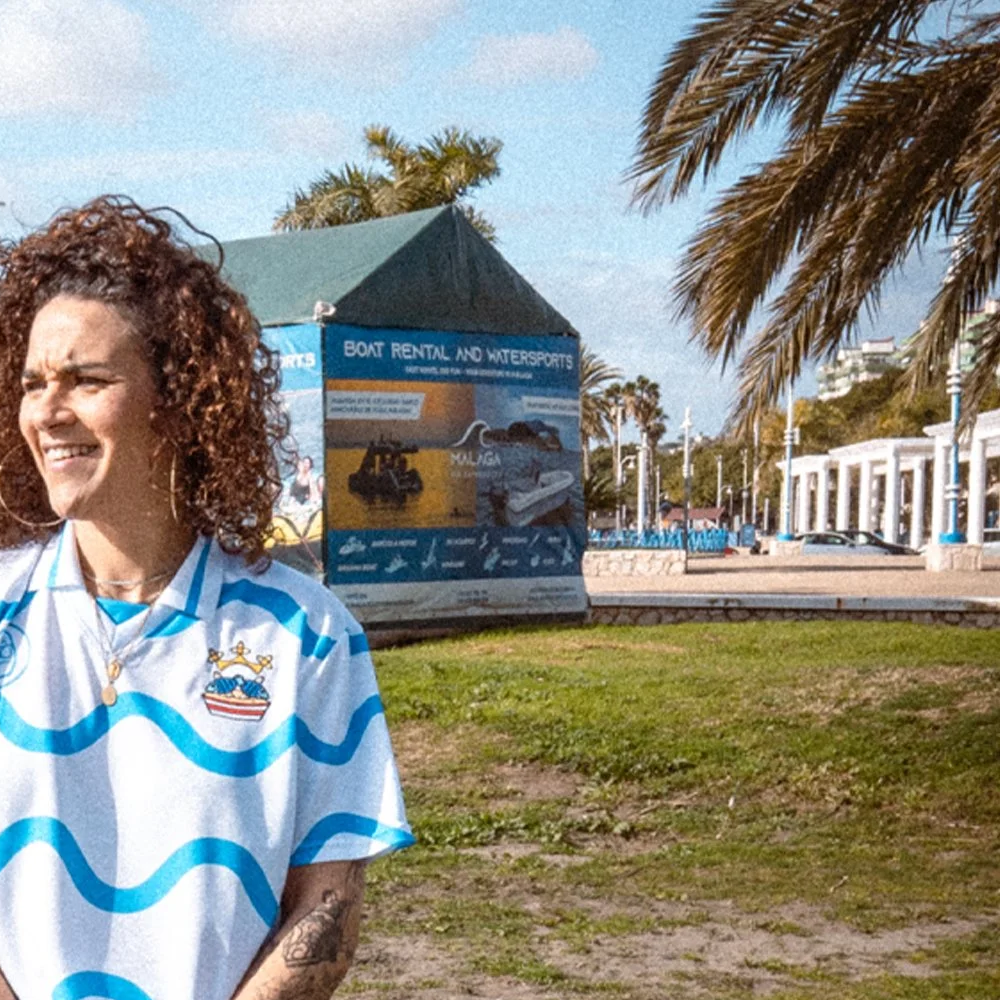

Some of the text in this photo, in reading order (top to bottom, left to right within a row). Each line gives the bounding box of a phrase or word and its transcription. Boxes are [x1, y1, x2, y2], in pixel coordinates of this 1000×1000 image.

[343, 340, 574, 370] BOAT RENTAL AND WATERSPORTS
